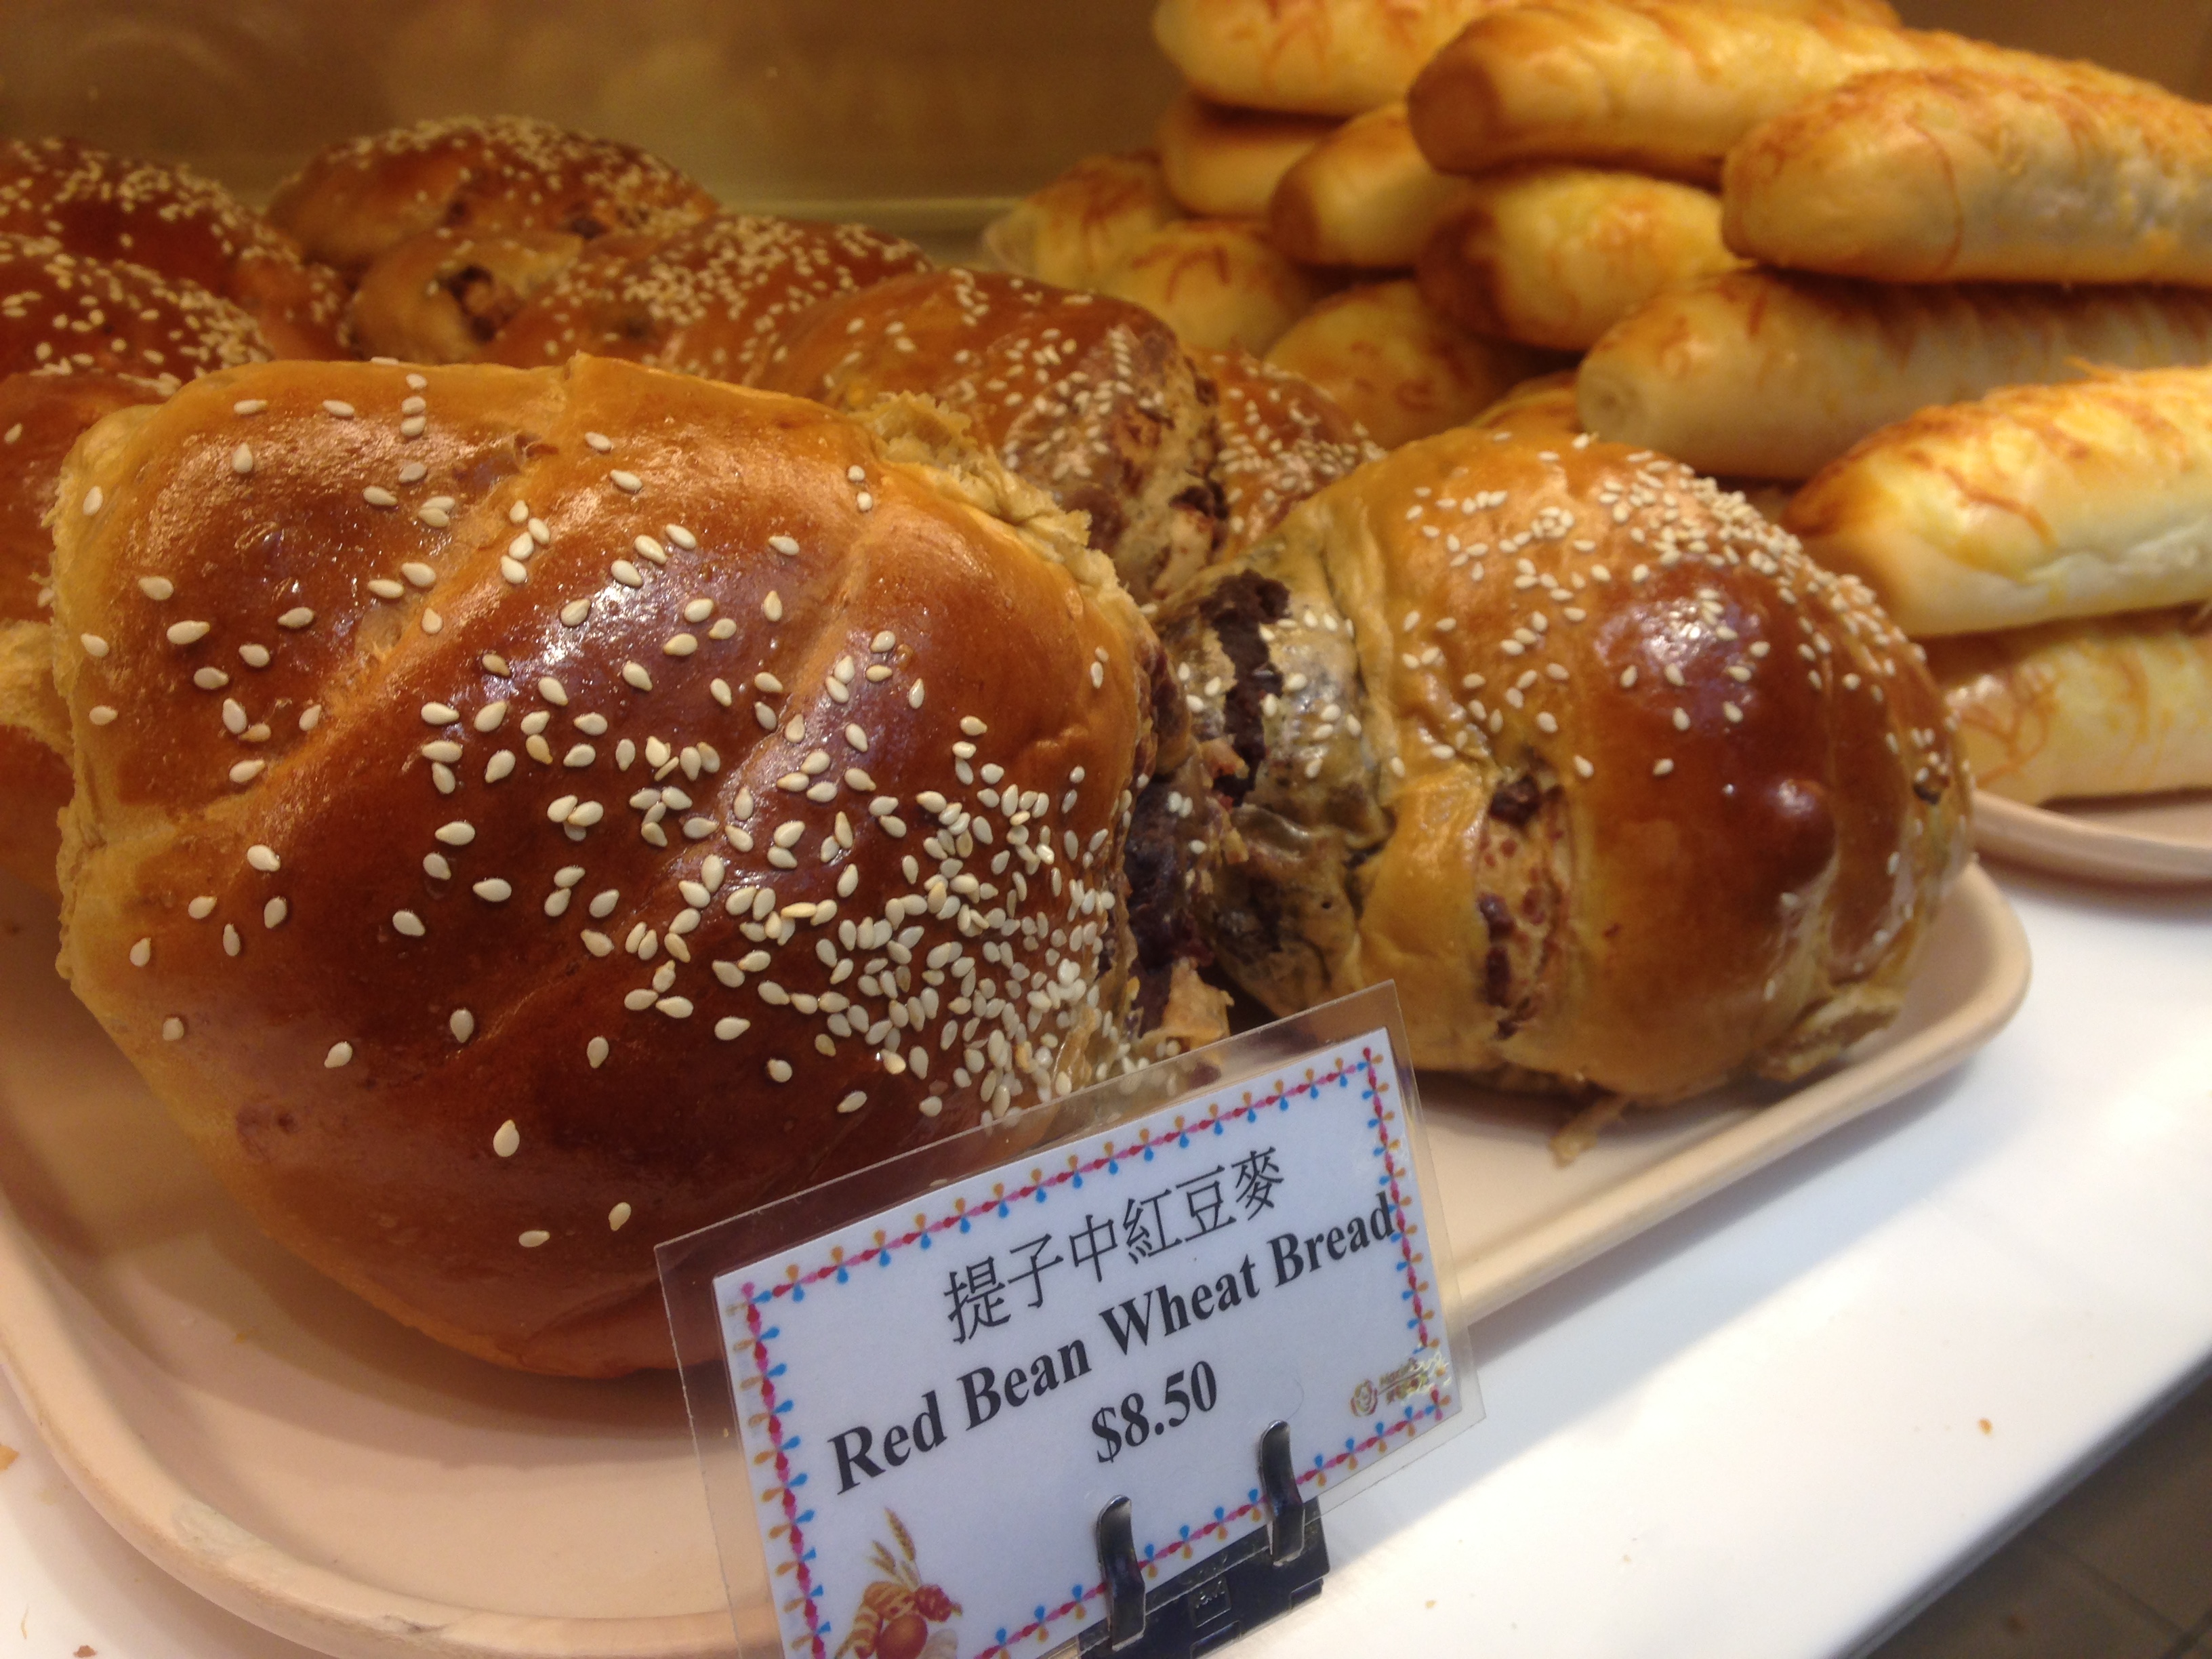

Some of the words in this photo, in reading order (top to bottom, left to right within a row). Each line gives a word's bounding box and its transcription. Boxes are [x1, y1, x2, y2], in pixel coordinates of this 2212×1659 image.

[827, 1392, 947, 1494] Red
[956, 1339, 1092, 1430] Bean
[1099, 1259, 1261, 1355] Wheat
[1266, 1191, 1395, 1288] Bread
[943, 1146, 1284, 1345] 提子中紅豆麥
[1090, 1361, 1218, 1464] $8.50
